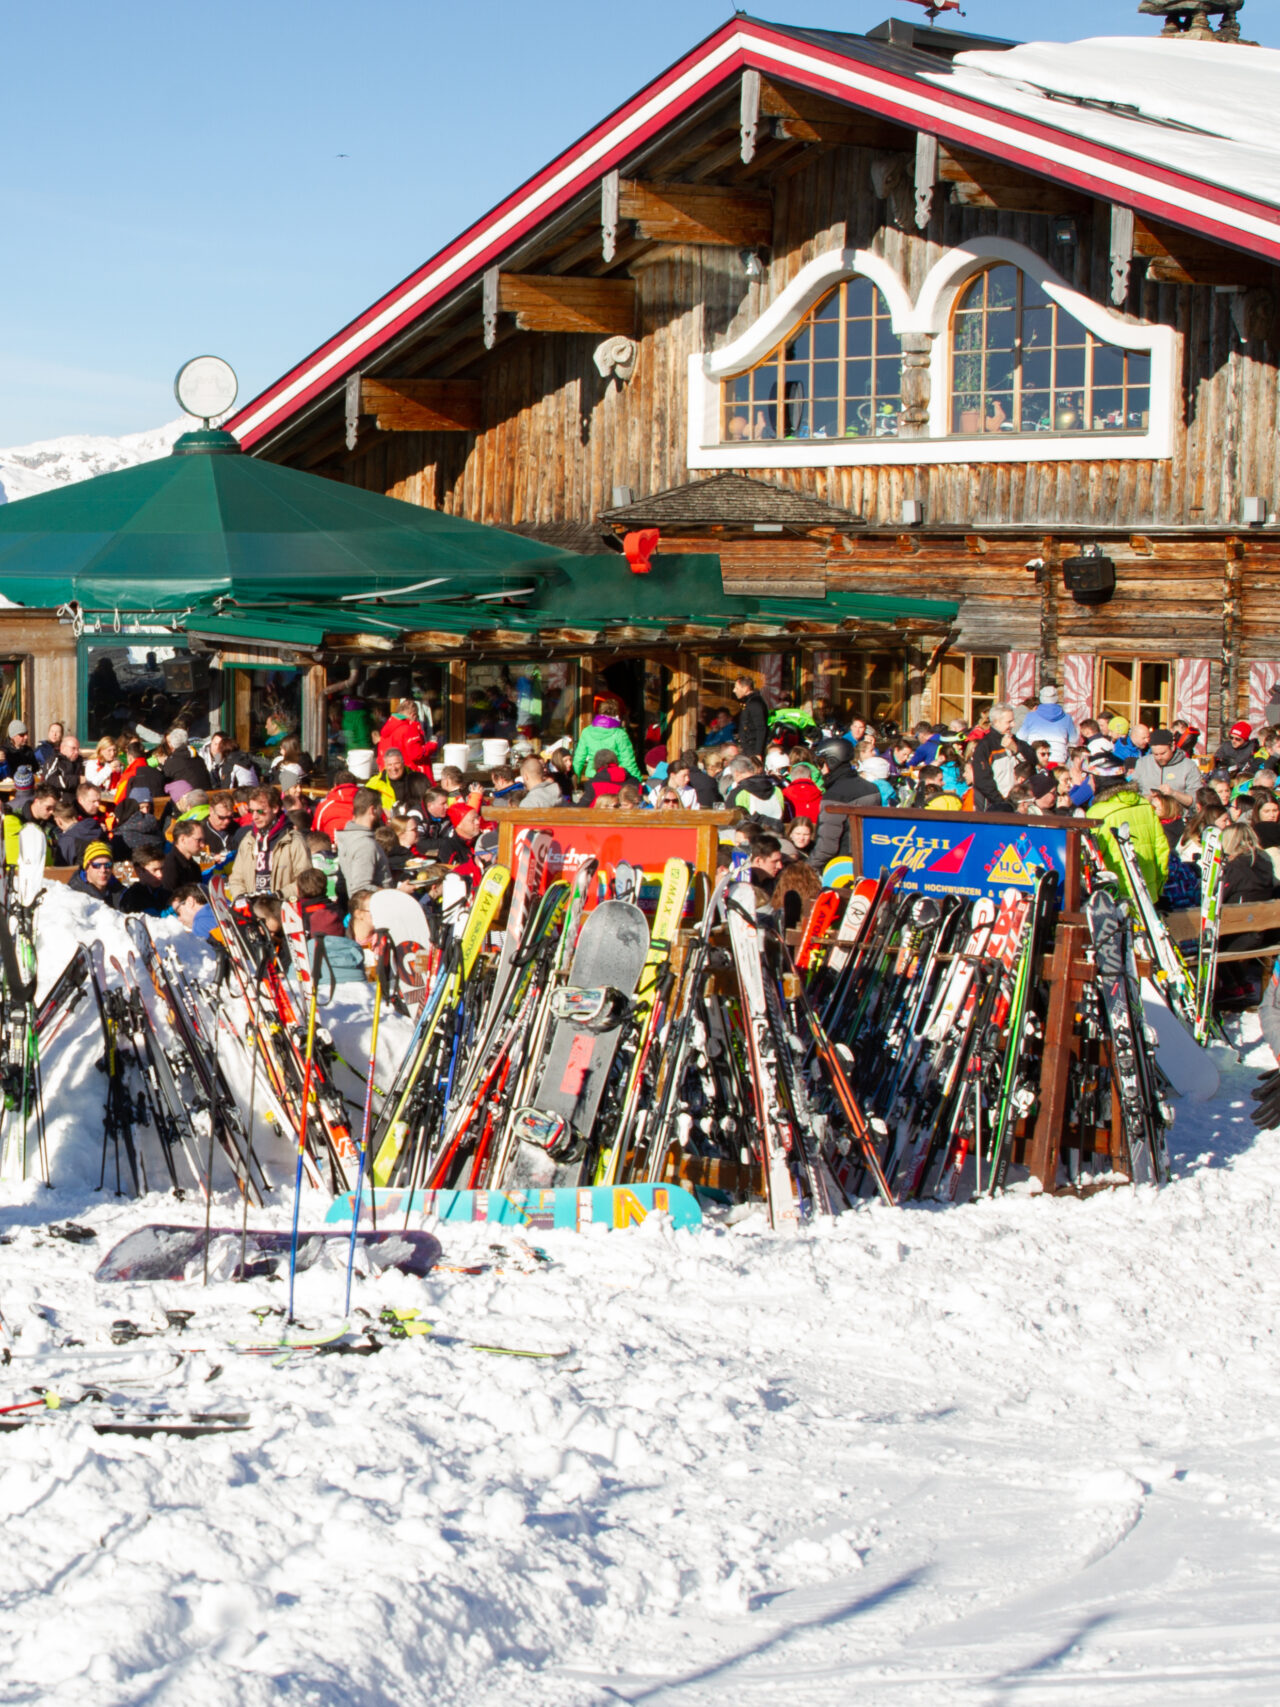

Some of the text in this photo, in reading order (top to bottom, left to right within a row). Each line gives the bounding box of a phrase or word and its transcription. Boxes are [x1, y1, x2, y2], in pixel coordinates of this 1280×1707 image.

[871, 834, 951, 850] SCHI
[890, 826, 933, 873] Lenz
[924, 883, 982, 896] HOCHWURZEN
